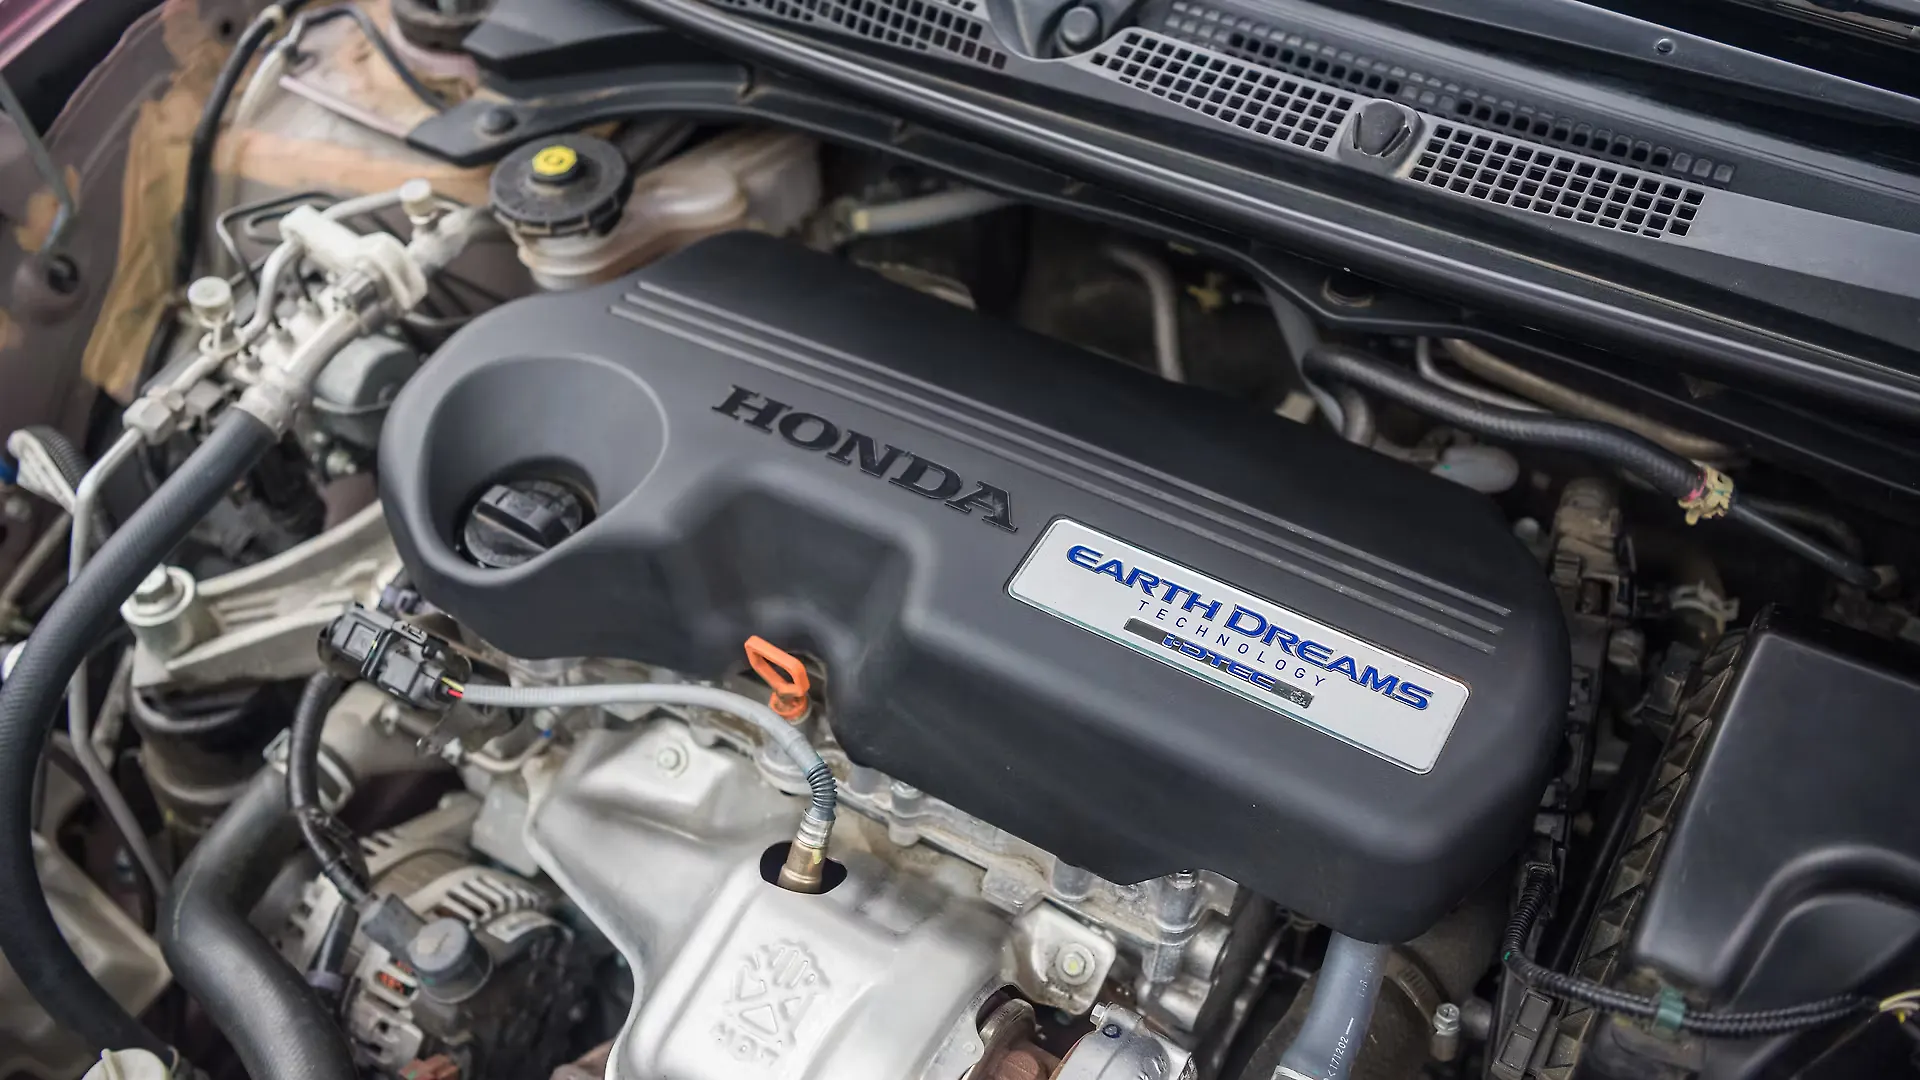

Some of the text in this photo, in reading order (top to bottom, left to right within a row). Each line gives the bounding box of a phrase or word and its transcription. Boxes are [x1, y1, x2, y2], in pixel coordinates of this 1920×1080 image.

[712, 384, 1019, 532] HONDA
[1066, 544, 1434, 711] EARTH DREAMS
[1138, 599, 1327, 687] TECHNOLOGY
